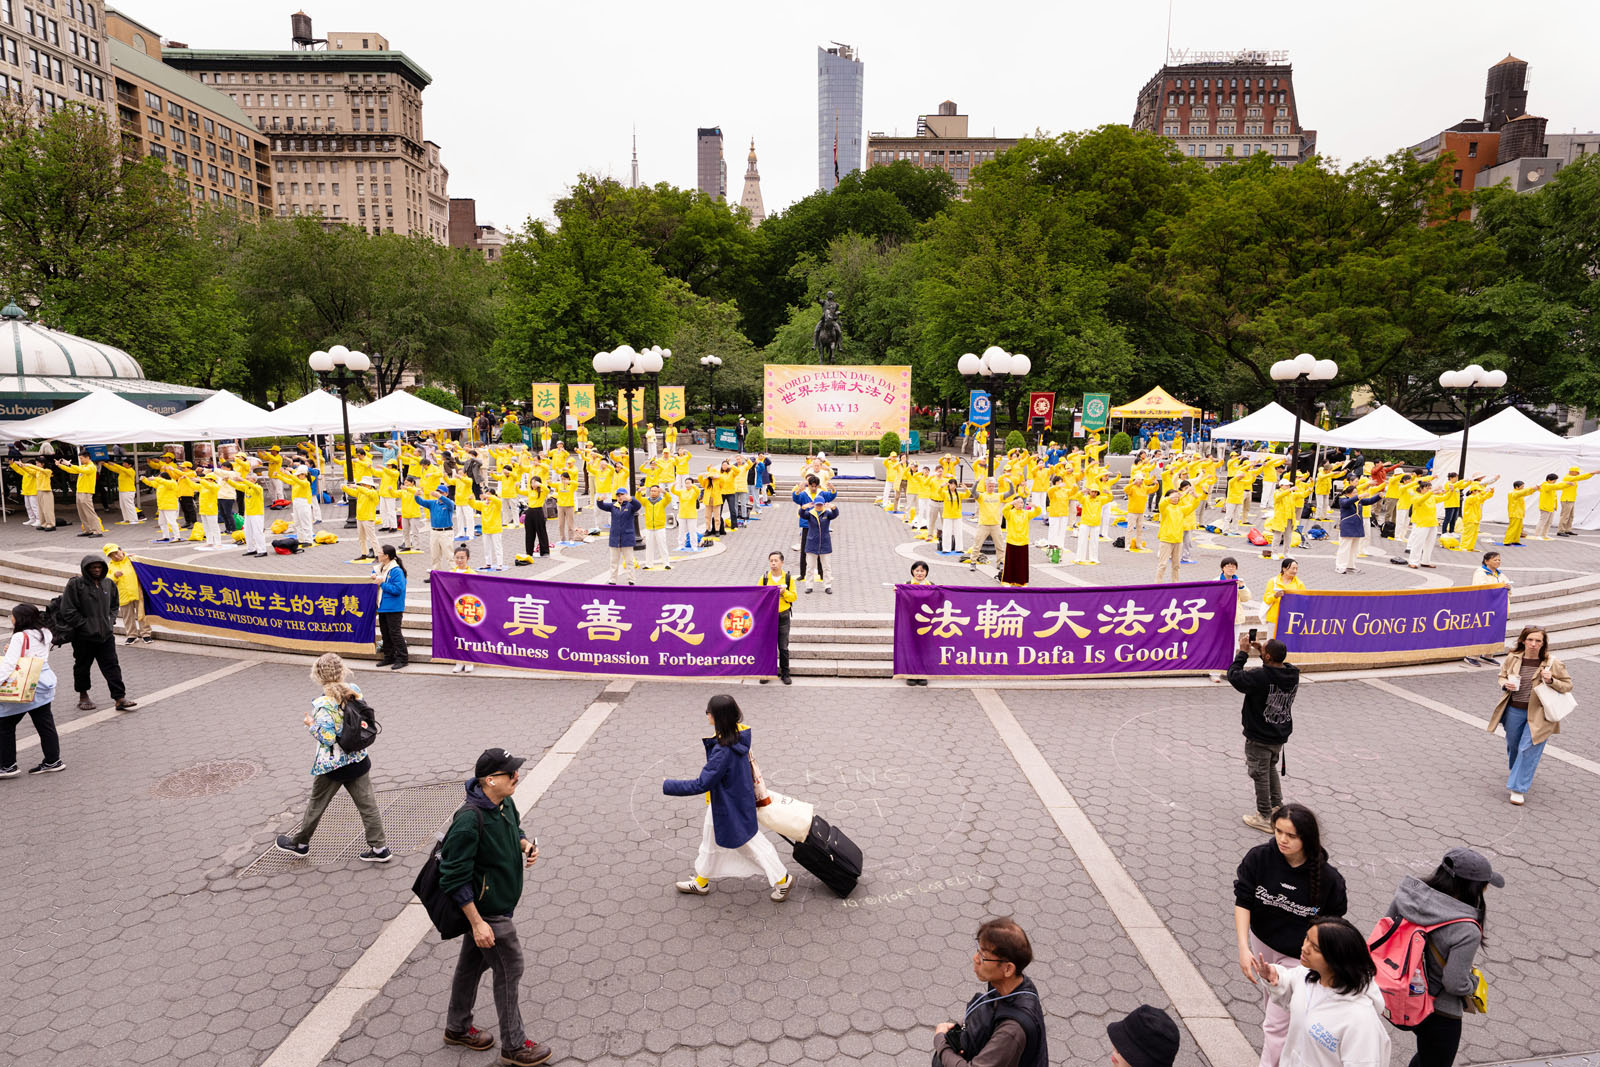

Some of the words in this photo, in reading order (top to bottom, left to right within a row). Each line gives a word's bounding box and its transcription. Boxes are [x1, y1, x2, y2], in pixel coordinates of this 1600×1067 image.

[1194, 51, 1234, 62] UNION
[1237, 49, 1290, 62] SQUARE
[776, 374, 812, 395] WORLD
[814, 370, 848, 381] FALUN
[850, 371, 876, 385] DAFA
[877, 377, 898, 393] DAY
[781, 379, 896, 406] 世界法輪大法日
[0, 403, 54, 416] Subway
[536, 389, 556, 409] 法
[573, 390, 592, 409] 輪
[663, 391, 681, 411] 法
[816, 403, 844, 413] MAY
[847, 403, 860, 413] 13
[150, 577, 364, 618] 大法是創世主的智慧
[165, 602, 194, 616] DAFA
[193, 606, 205, 617] IS
[205, 609, 227, 621] THE
[227, 612, 269, 628] WISDOM
[269, 618, 283, 629] OF
[284, 620, 306, 632] THE
[307, 621, 355, 633] CREATOR
[914, 598, 1216, 639] 法輪大法好
[453, 635, 549, 660] Truthfulness
[557, 646, 650, 666] Compassion
[658, 652, 756, 667] Forbearance
[938, 645, 1009, 666] Falun
[1017, 644, 1075, 666] Dafa
[1083, 644, 1106, 664] Is
[1114, 640, 1189, 663] Good!
